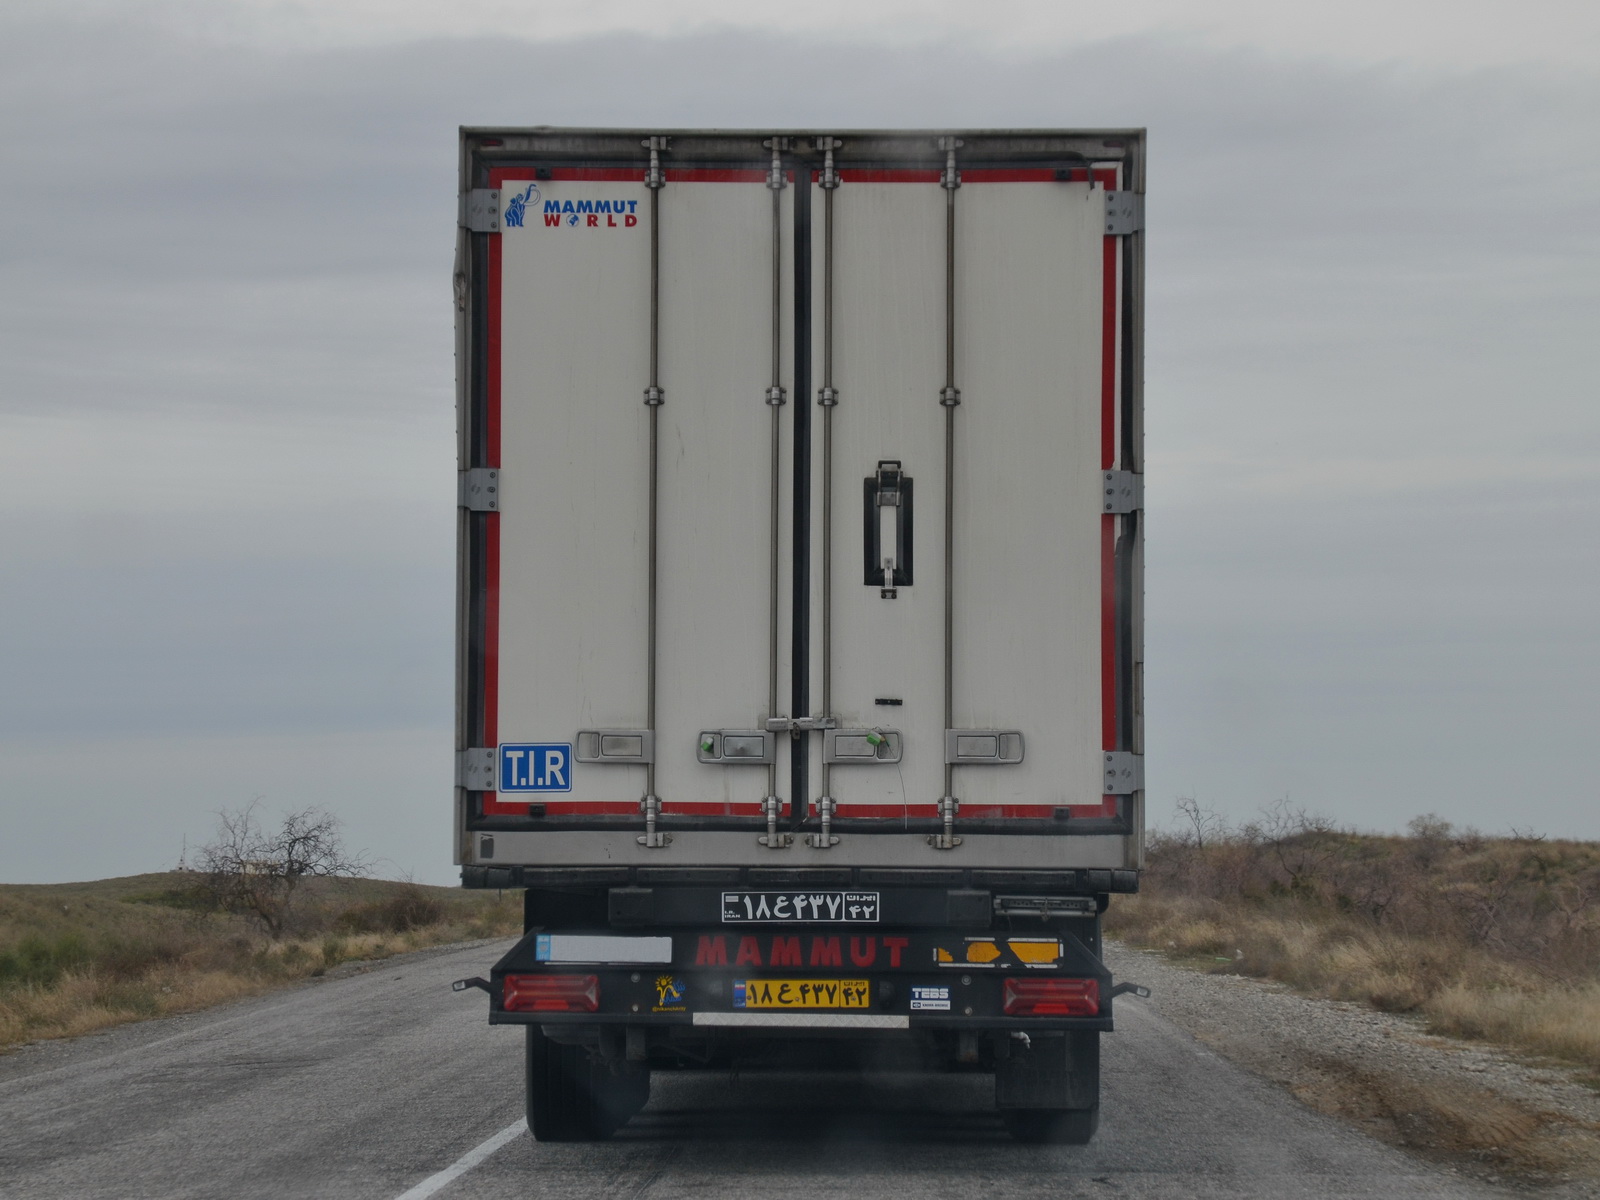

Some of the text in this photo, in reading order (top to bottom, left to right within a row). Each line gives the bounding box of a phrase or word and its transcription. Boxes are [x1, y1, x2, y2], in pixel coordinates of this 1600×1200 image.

[543, 200, 637, 214] MAMMUT
[543, 214, 637, 227] WORLD
[505, 751, 565, 786] T.I.R
[695, 935, 909, 968] MAMMUT
[912, 988, 949, 999] TEBS
